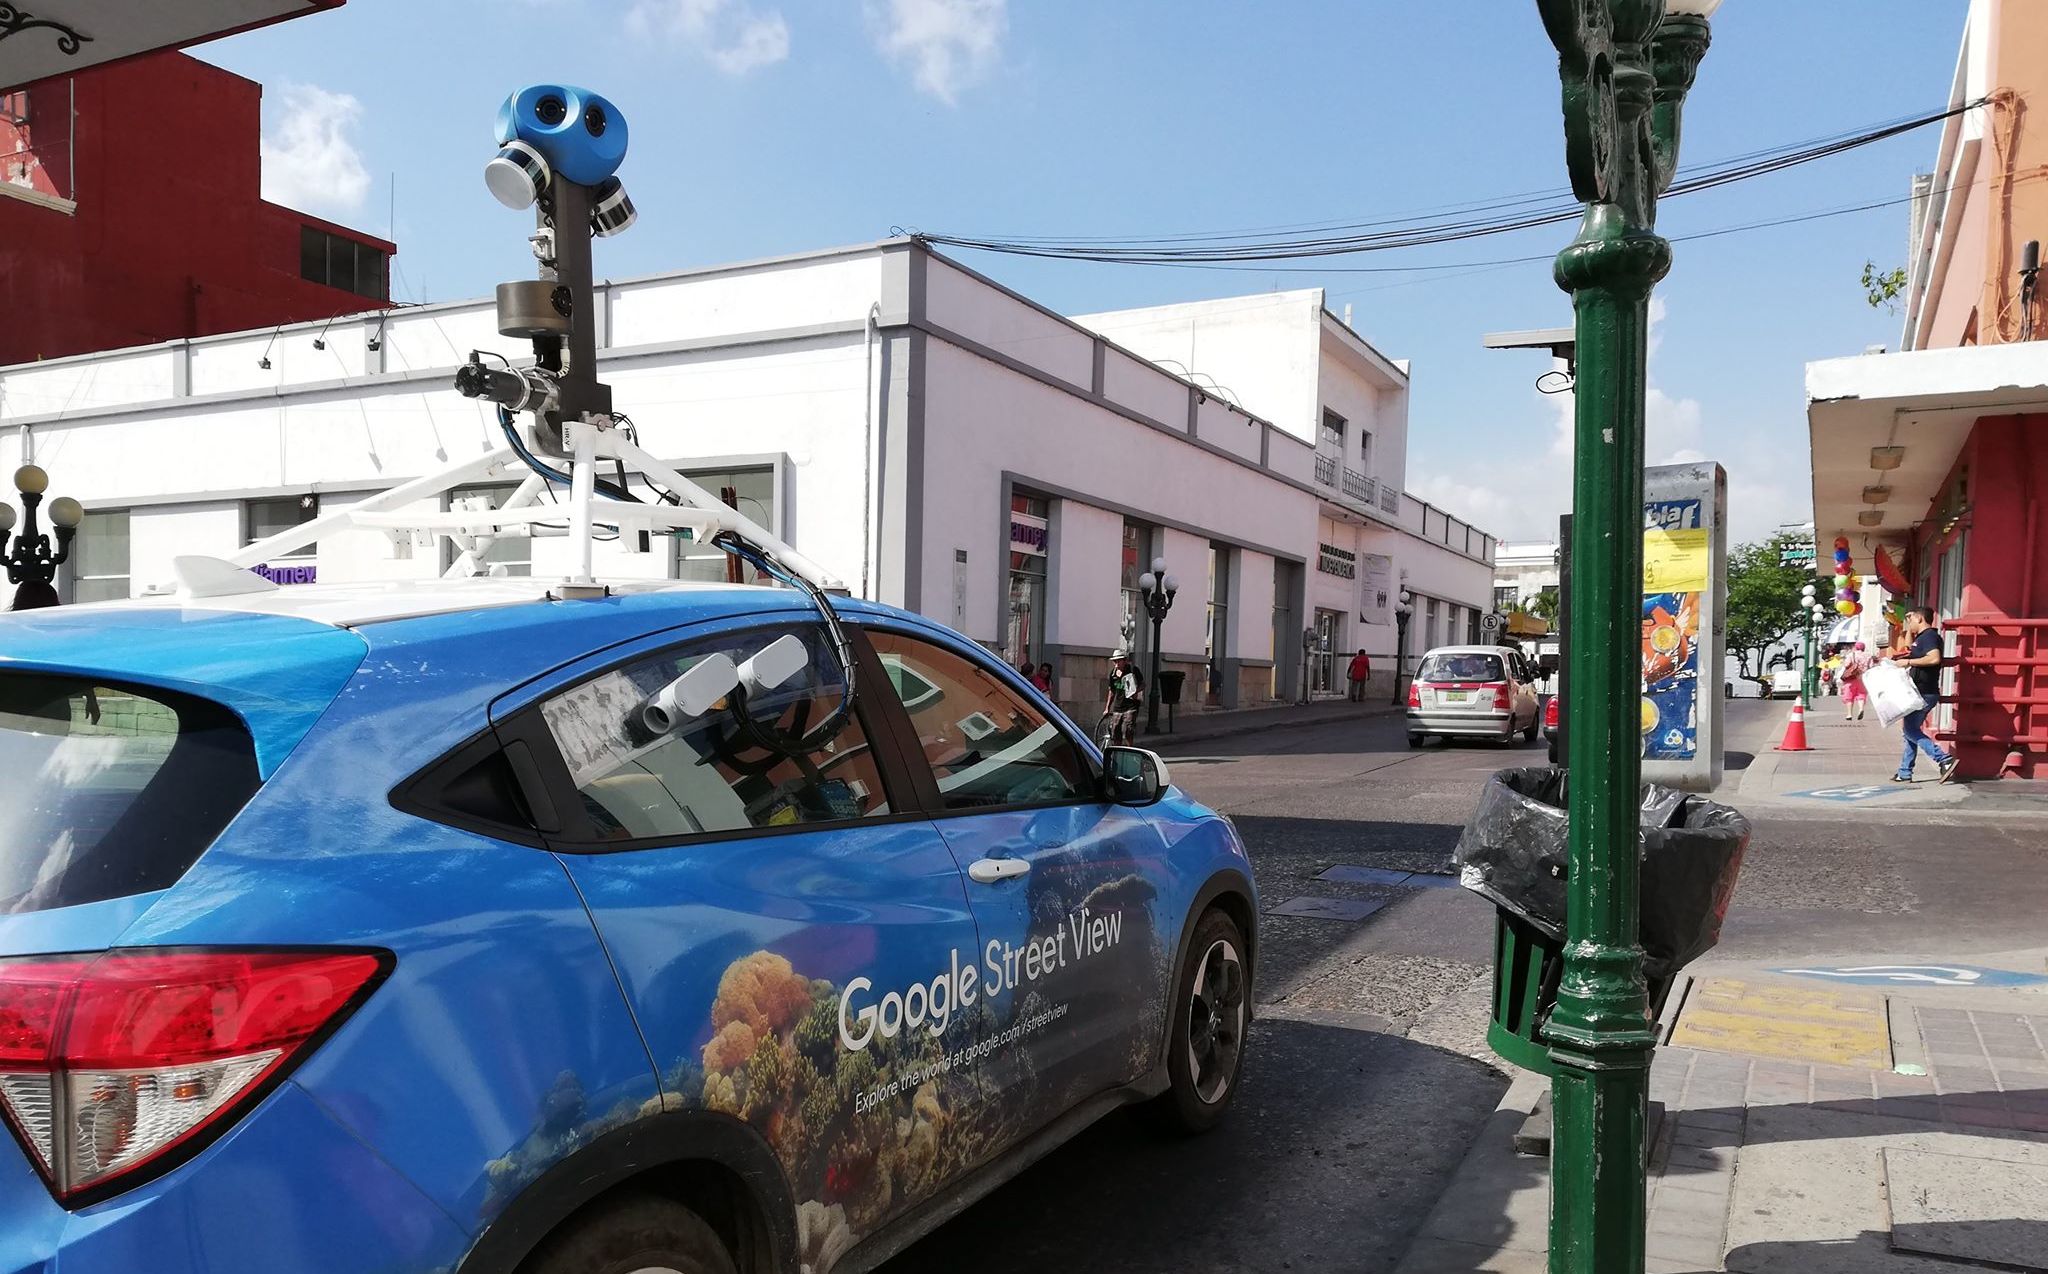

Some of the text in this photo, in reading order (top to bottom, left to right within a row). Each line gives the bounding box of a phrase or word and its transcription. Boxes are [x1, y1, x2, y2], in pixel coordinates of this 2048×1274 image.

[838, 907, 1122, 1051] Google Street View
[855, 1081, 898, 1115] Explore
[901, 1071, 919, 1092] the
[920, 1052, 951, 1081] world
[953, 1048, 965, 1067] at
